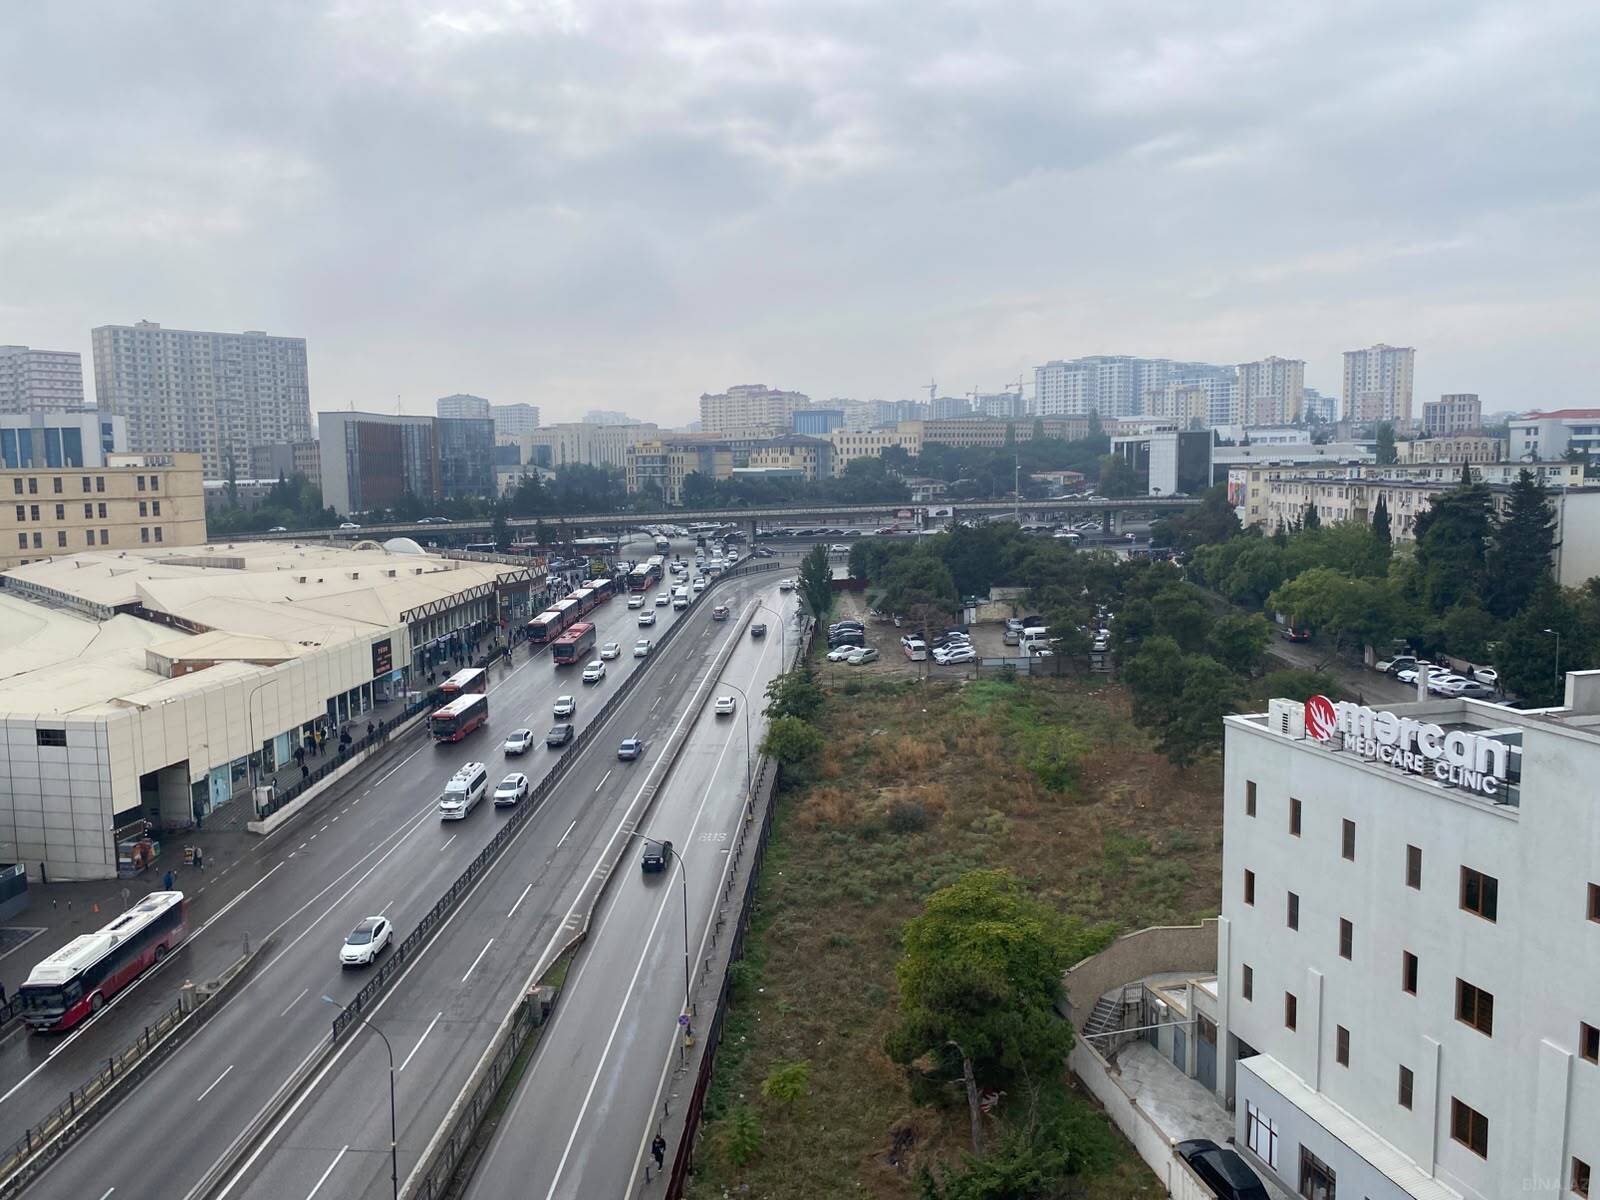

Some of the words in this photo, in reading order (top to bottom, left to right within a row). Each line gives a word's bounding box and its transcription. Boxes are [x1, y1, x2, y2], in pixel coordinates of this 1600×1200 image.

[1335, 700, 1508, 779] mərcan
[1344, 733, 1425, 773] MEDICARE
[1434, 760, 1498, 794] CLINIC
